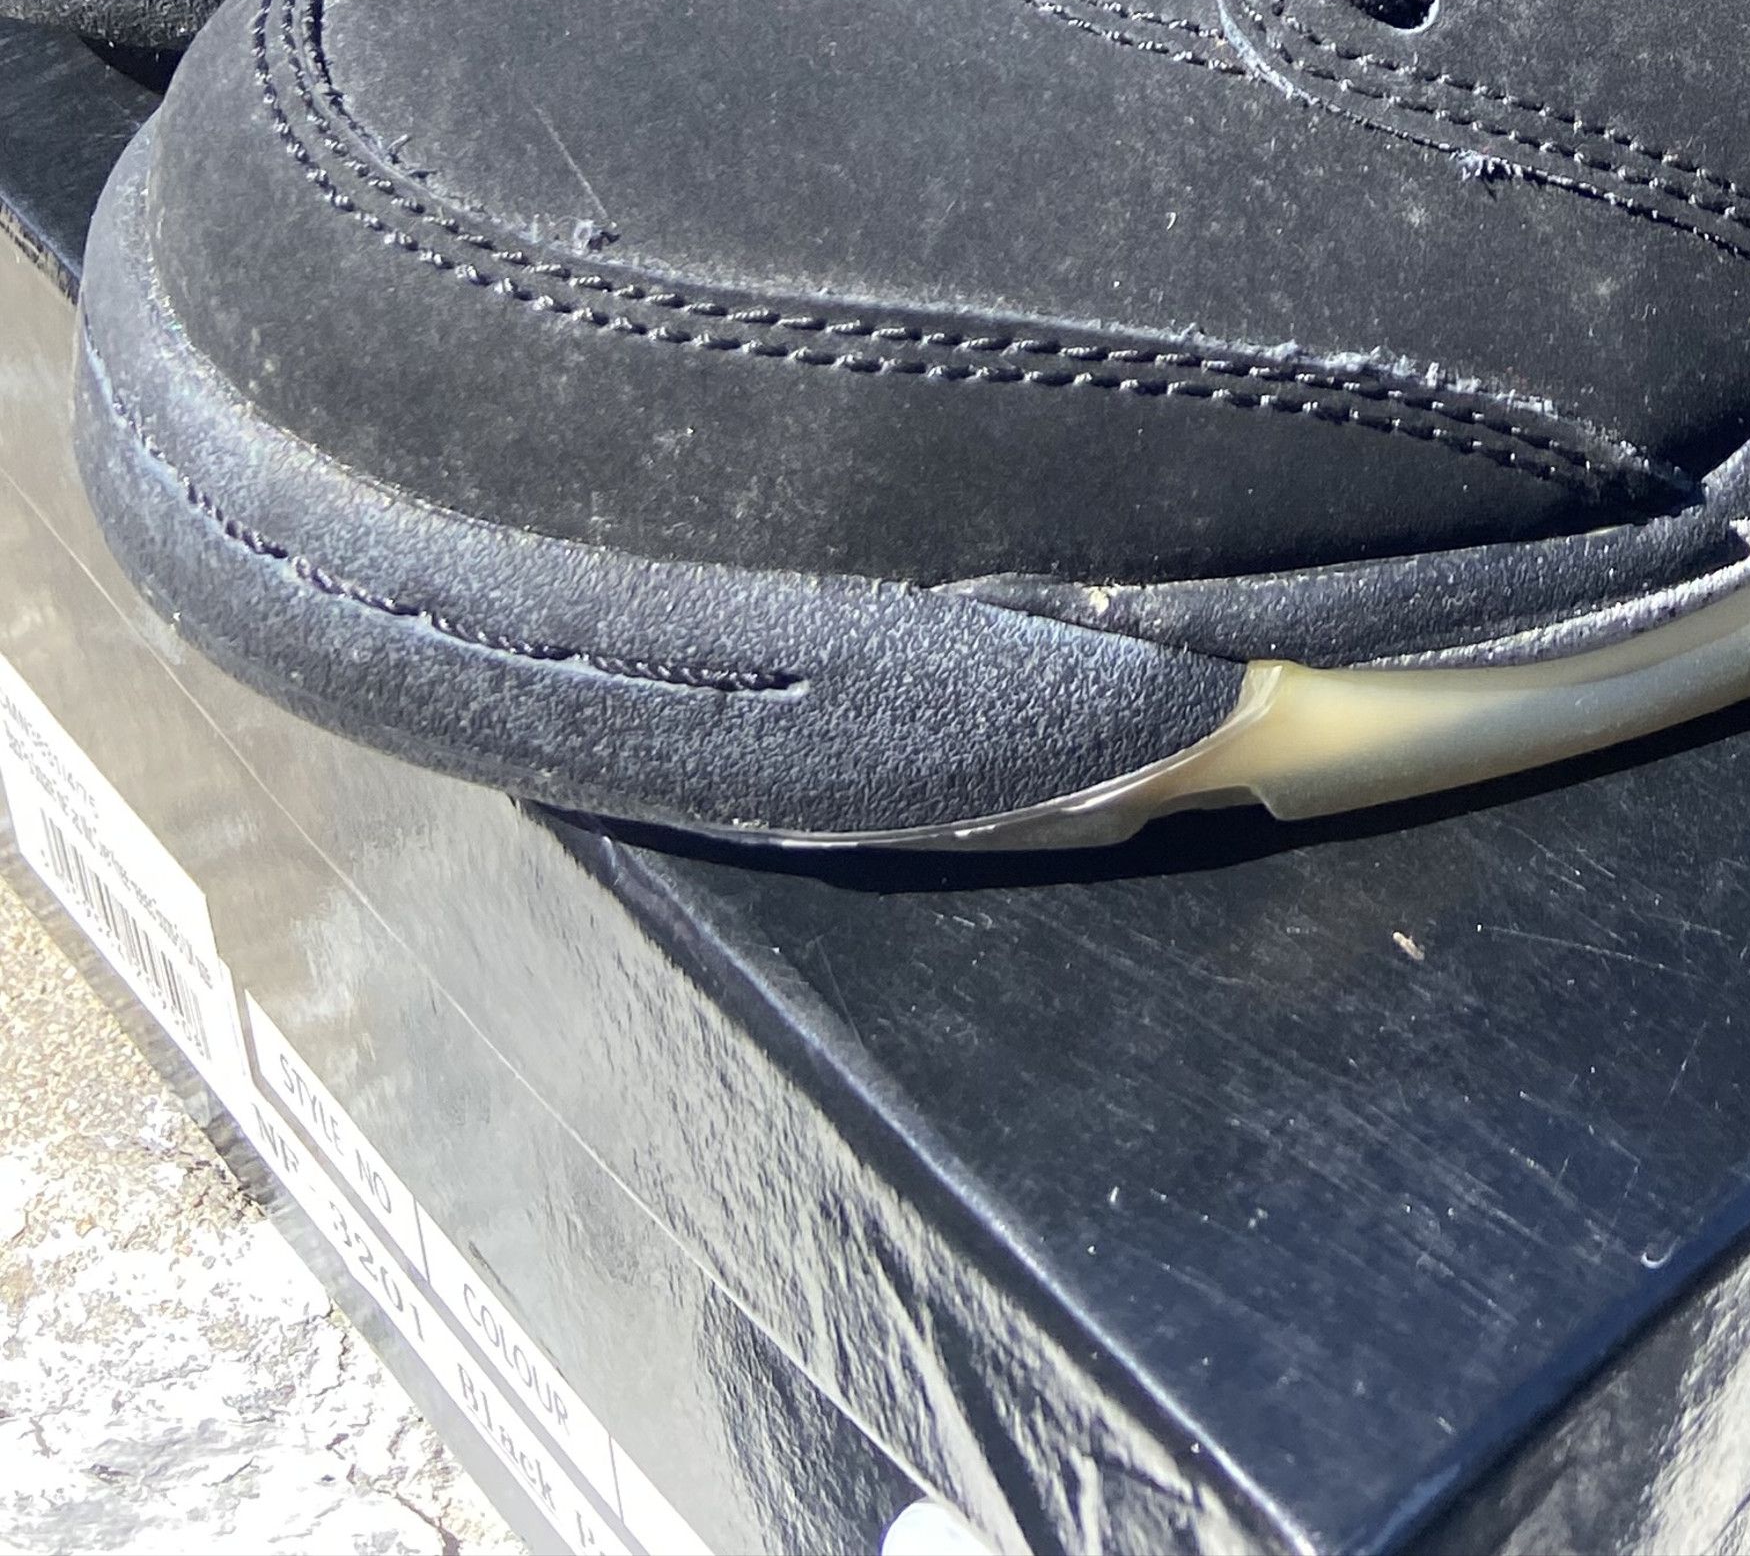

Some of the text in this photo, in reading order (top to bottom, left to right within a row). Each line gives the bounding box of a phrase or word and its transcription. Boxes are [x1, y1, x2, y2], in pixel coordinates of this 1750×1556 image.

[279, 1052, 392, 1214] STYLE NO
[456, 1361, 557, 1511] Black
[463, 1282, 571, 1437] COLOUR
